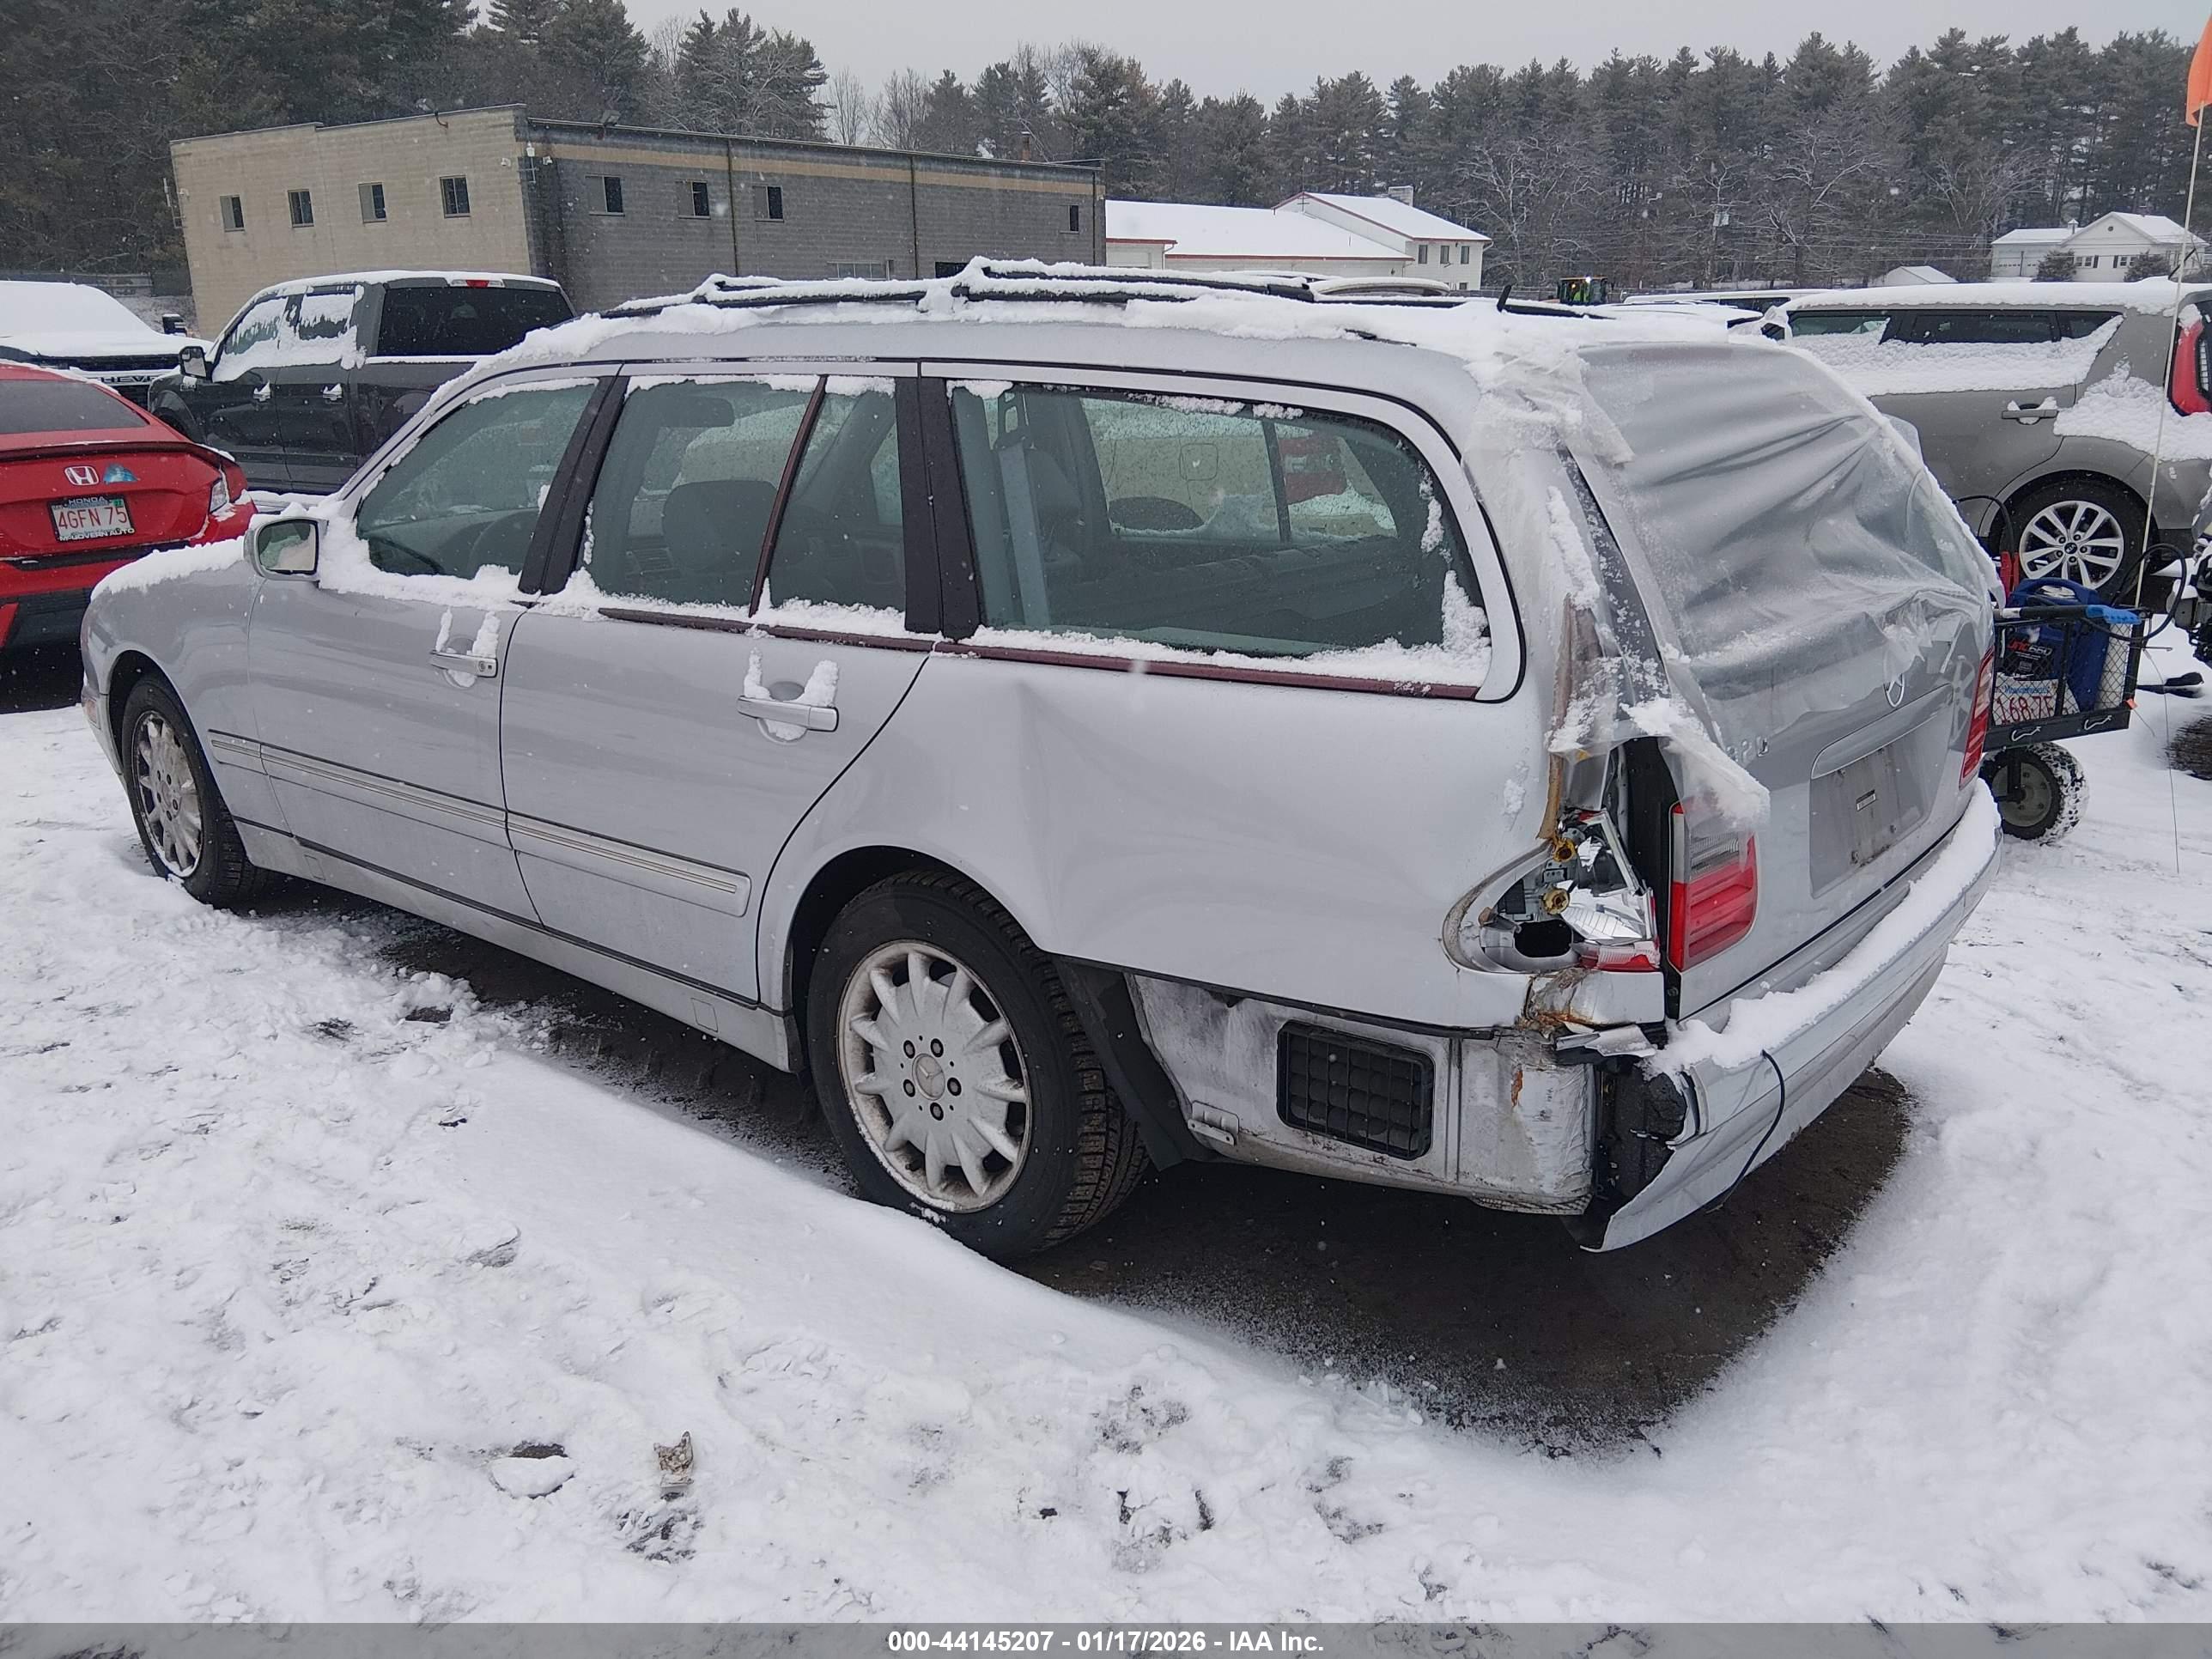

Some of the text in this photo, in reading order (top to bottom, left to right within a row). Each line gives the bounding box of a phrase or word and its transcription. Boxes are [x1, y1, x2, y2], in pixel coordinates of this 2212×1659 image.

[69, 496, 109, 505] HONDA
[58, 506, 128, 530] 4GFN 75
[110, 528, 135, 537] AUTO
